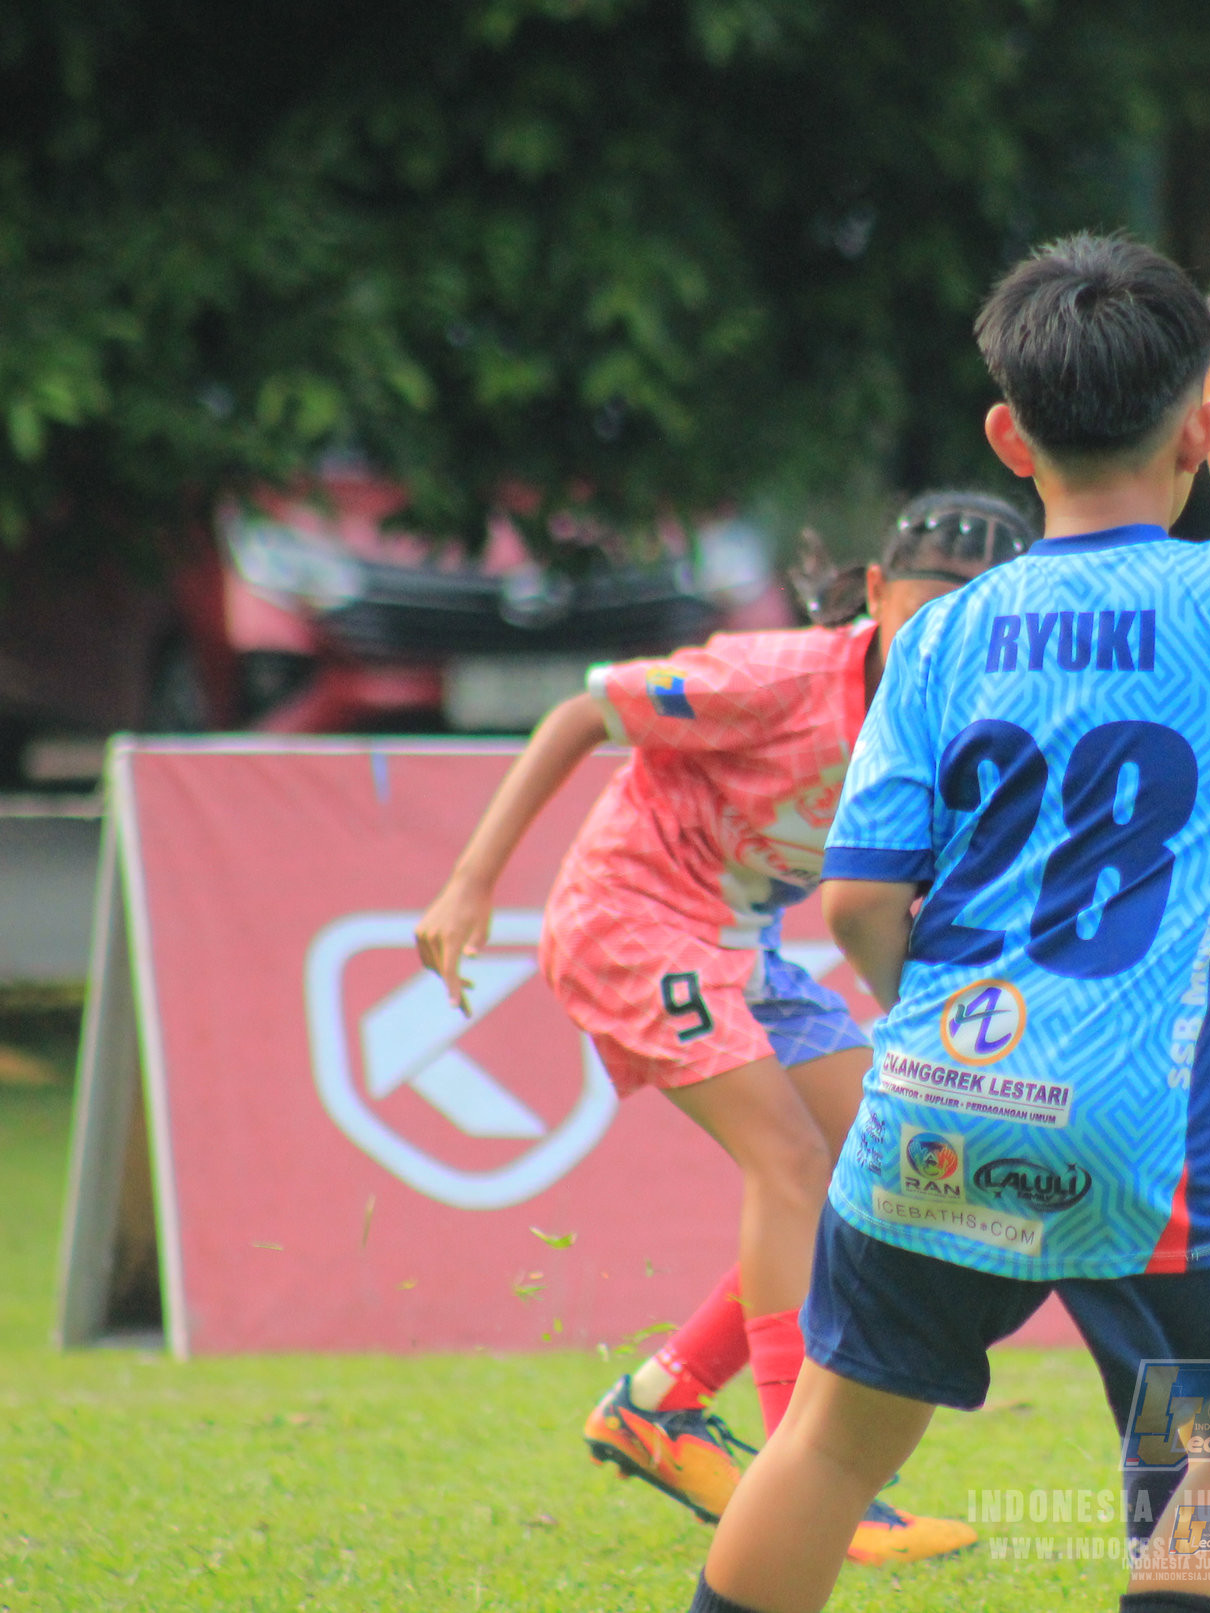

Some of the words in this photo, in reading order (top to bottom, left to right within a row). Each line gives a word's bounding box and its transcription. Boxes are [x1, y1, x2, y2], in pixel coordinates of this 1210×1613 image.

[985, 609, 1156, 673] RYUKI
[909, 719, 1199, 979] 28
[661, 971, 714, 1041] 9
[1167, 1017, 1204, 1090] SSB
[924, 1093, 959, 1108] SUPLIER
[1029, 1111, 1056, 1123] UMUM
[989, 1078, 1069, 1107] LESTARI
[905, 1176, 960, 1196] RAN
